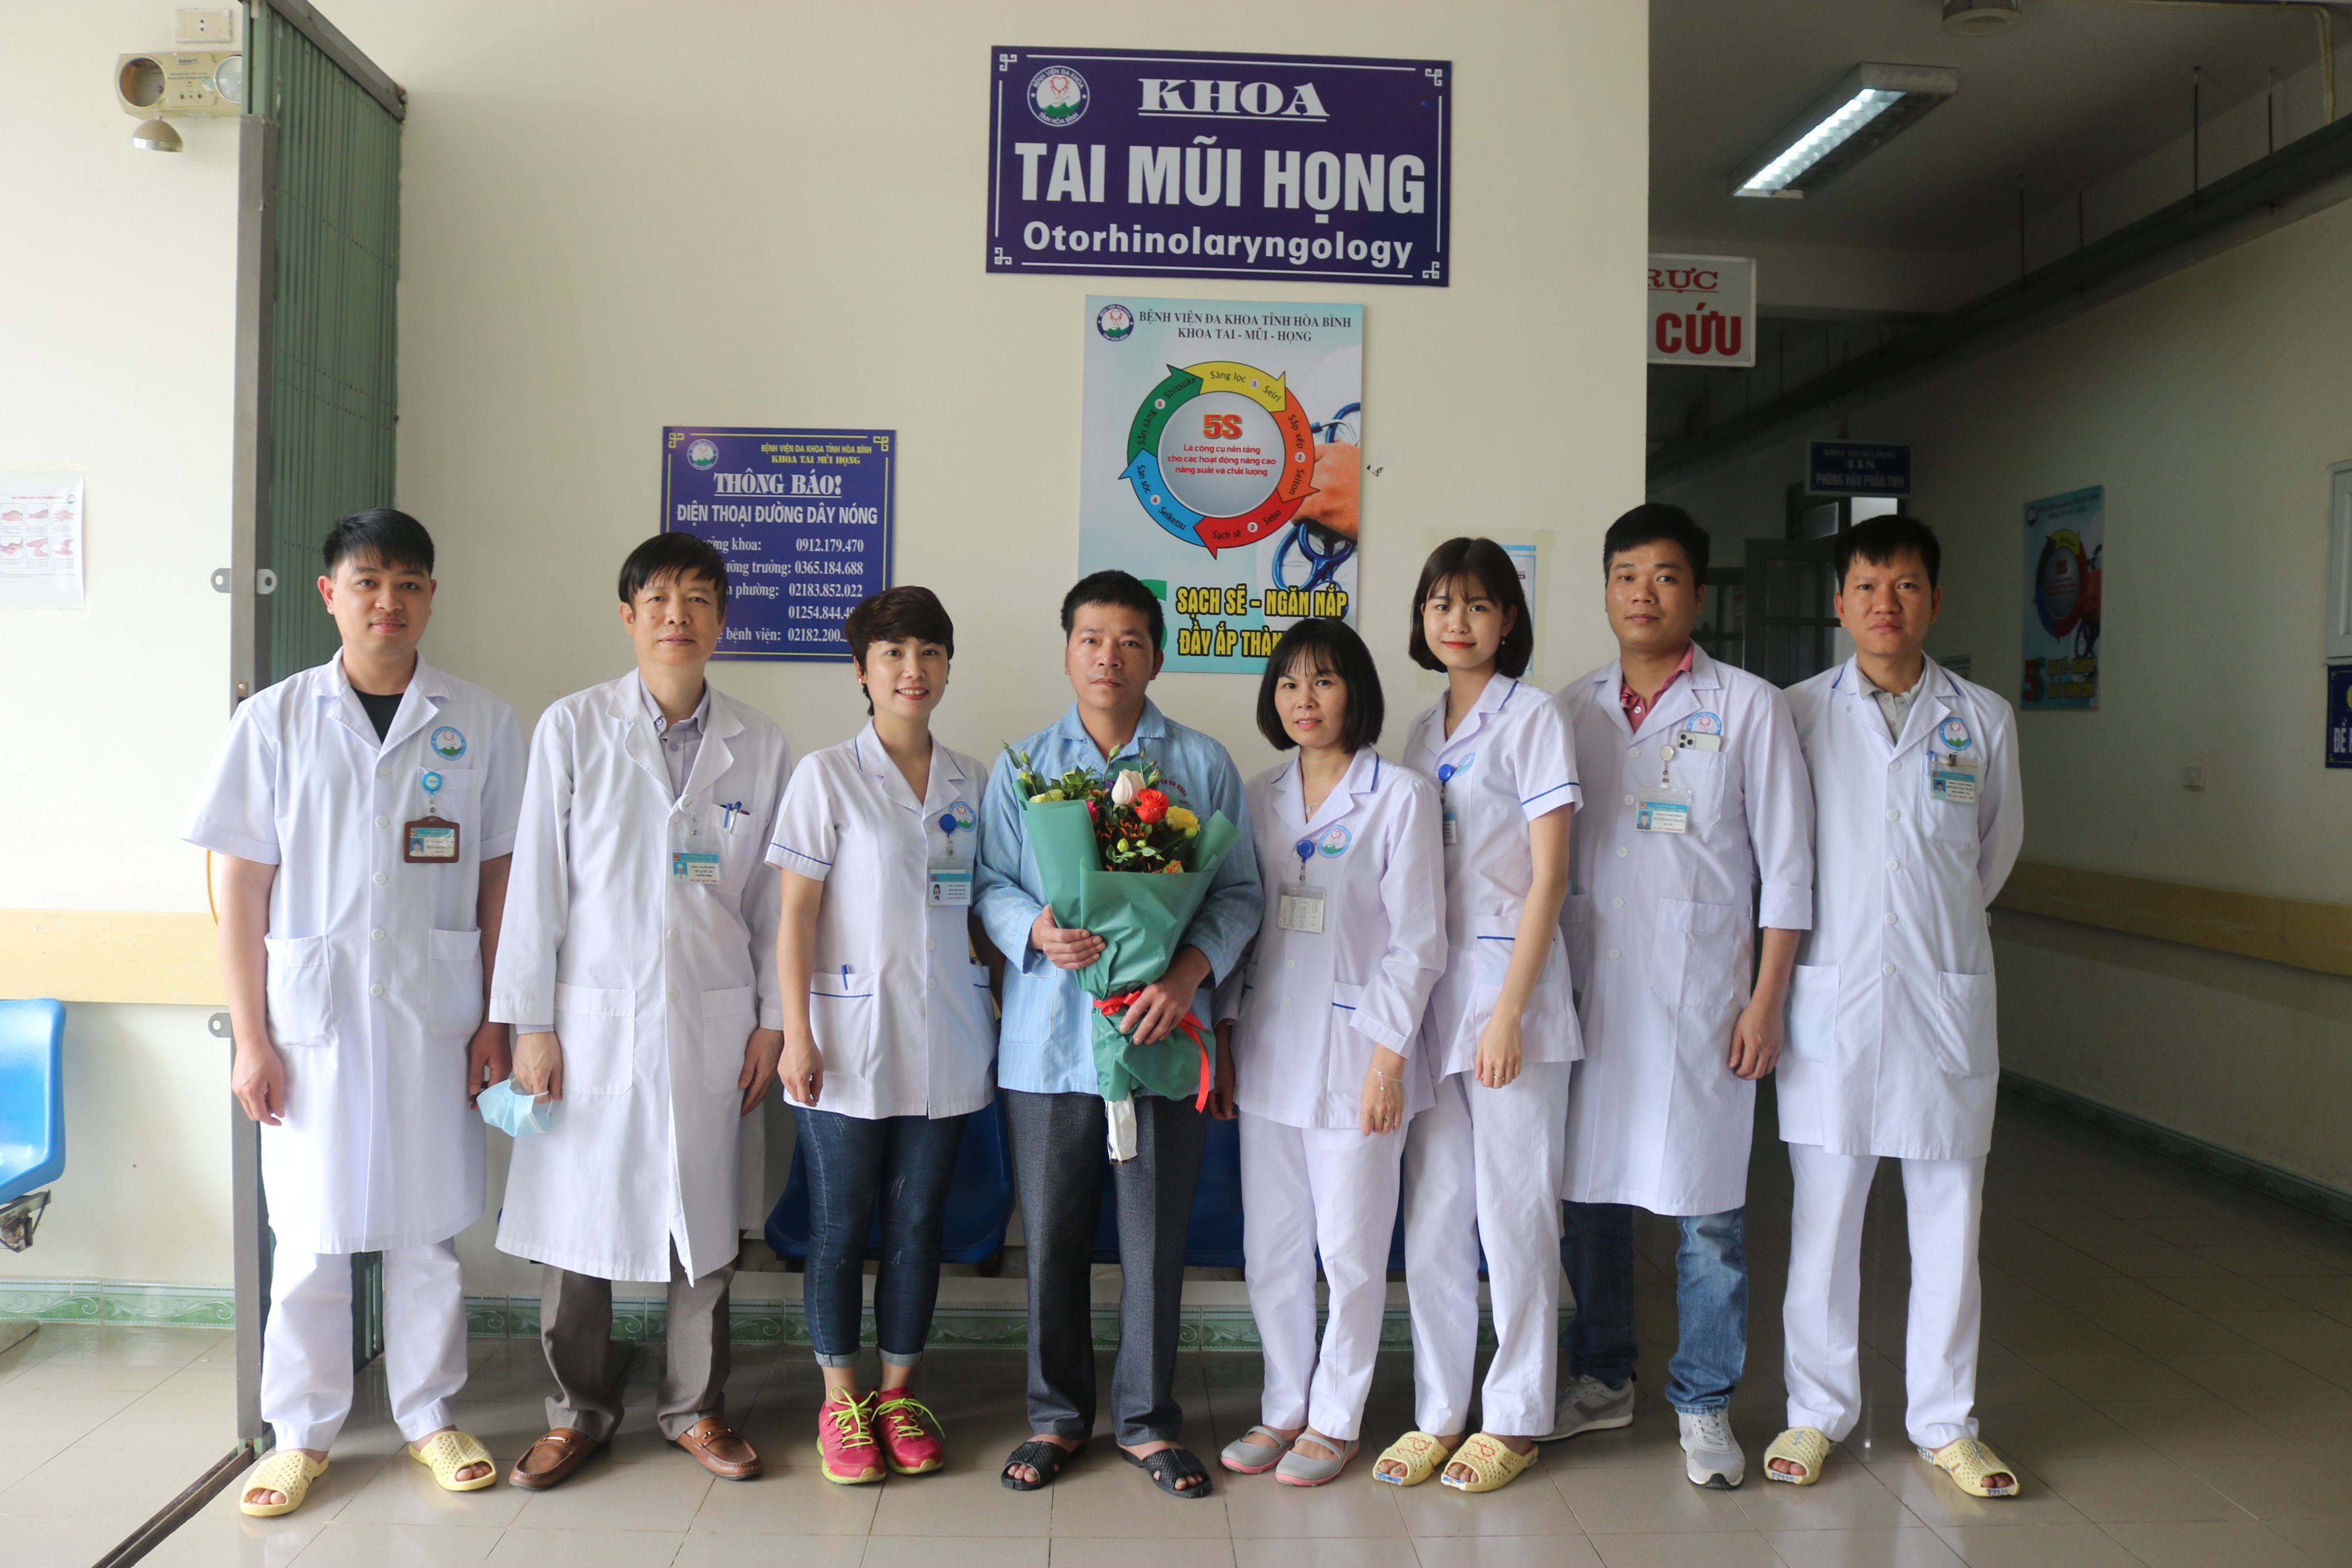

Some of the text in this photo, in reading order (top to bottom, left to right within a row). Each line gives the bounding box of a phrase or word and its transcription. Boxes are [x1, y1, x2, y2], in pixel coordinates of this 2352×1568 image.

[1070, 73, 1084, 89] KHOA
[1138, 78, 1330, 116] KHOA
[1014, 135, 1426, 225] TAI MŨI HỌNG
[1023, 221, 1413, 269] Otorhinolaryngology
[1648, 268, 1718, 293] RỰC
[1139, 308, 1351, 328] BỆNH VIỆN ĐA KHOA TỈNH HÒA BÌNH
[1177, 328, 1212, 340] KHOA
[1215, 329, 1235, 339] TAI
[1244, 327, 1268, 341] MŨI
[1277, 330, 1312, 343] HỌNG
[1656, 302, 1741, 356] CỨU
[1164, 376, 1196, 399] Shitsuke
[1263, 385, 1282, 402] Seiri
[1203, 414, 1242, 439] 5S
[761, 442, 778, 454] BỆNH
[779, 442, 794, 454] VIỆN
[806, 445, 824, 453] KHOA
[842, 443, 855, 453] HÒA
[857, 443, 872, 454] BÌNH
[1195, 445, 1214, 453] công
[771, 455, 797, 464] KHOA
[800, 455, 814, 464] TAI
[836, 456, 860, 466] HỌNG
[1199, 456, 1217, 464] hoạt
[1219, 457, 1239, 465] động
[713, 468, 842, 495] THÔNG BÁO!
[677, 500, 878, 527] ĐIỆN THOẠI ĐƯỜNG DÂY NÓNG
[1158, 506, 1186, 530] Seiketsu
[731, 537, 762, 551] khoa:
[796, 538, 864, 553] 0912.179.470
[1212, 531, 1231, 540] Sạch
[724, 559, 863, 577] ưỡng trưởng: 0365.184.688
[736, 582, 779, 599] phường:
[789, 583, 863, 597] 02183.852.022
[1176, 587, 1222, 620] SẠCH
[1225, 583, 1246, 616] SẼ
[1265, 585, 1310, 617] NGĂN
[1313, 582, 1349, 617] NẮP
[726, 627, 752, 643] bệnh
[755, 627, 781, 643] viện:
[787, 628, 848, 643] 02182.200.
[1177, 619, 1284, 657] ĐẦY ẮP THÀN
[2023, 656, 2046, 703] 5S
